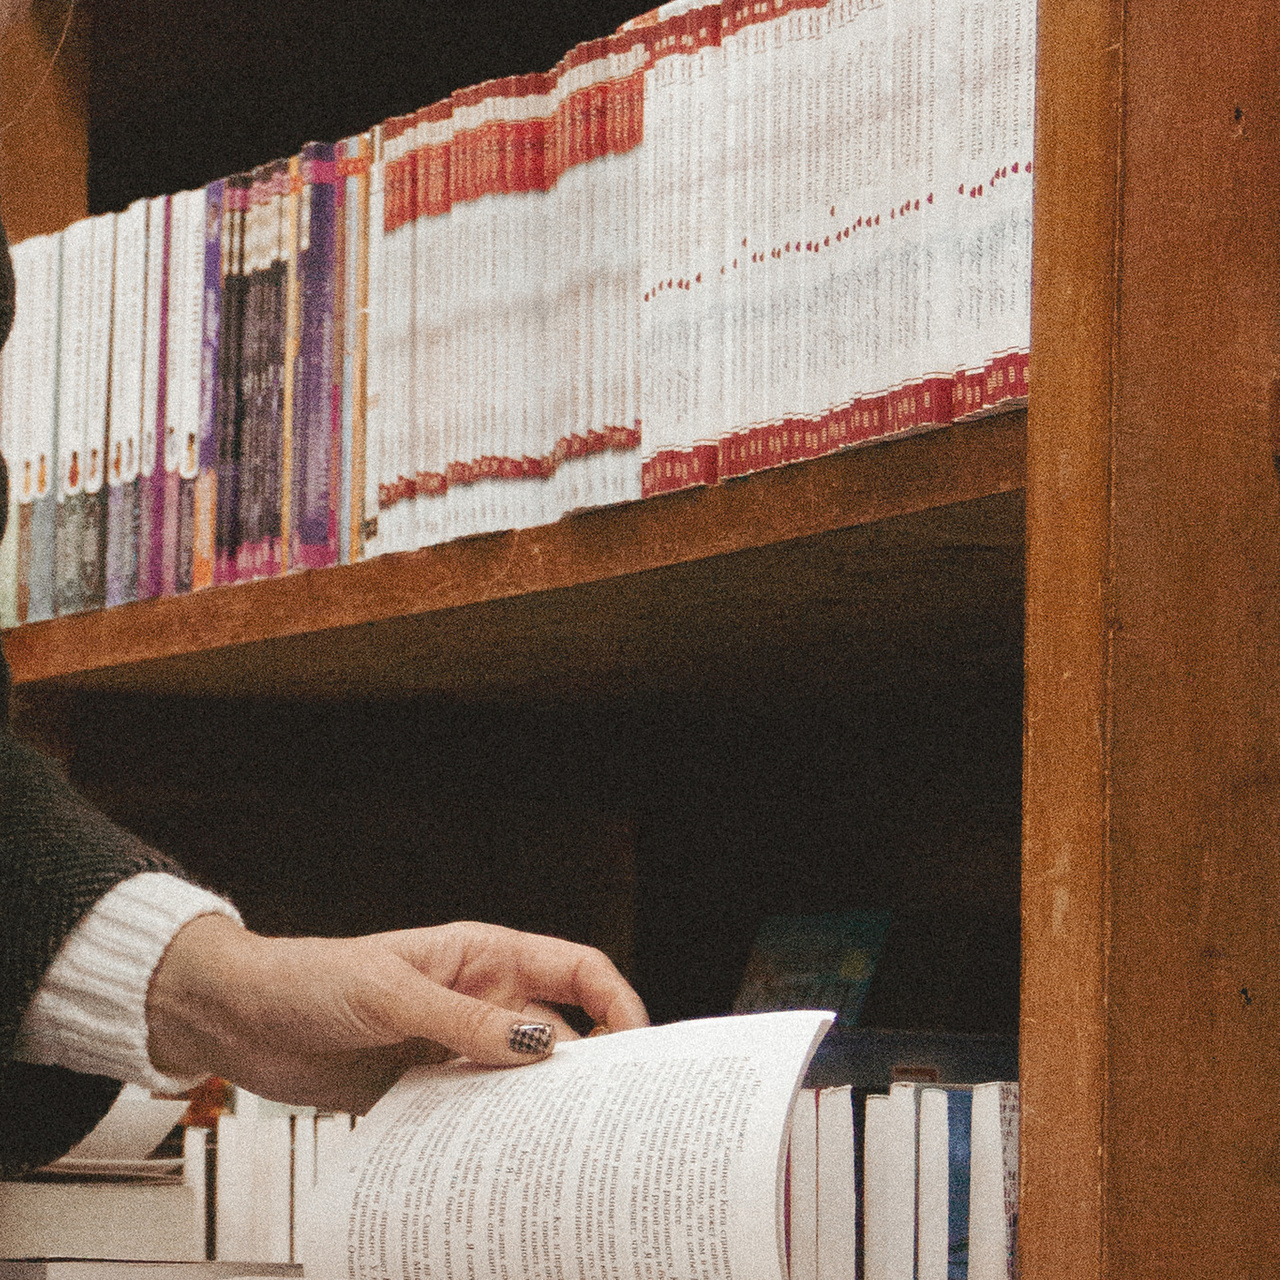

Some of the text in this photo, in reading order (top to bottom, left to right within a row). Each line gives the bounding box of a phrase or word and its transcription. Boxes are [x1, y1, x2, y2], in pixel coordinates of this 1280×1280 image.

[614, 1110, 634, 1162] полностью
[640, 1130, 649, 1147] что
[648, 1127, 660, 1152] меня
[472, 1155, 484, 1184] собой
[525, 1158, 536, 1180] дать
[636, 1150, 644, 1163] он
[654, 1120, 672, 1191] придерживает
[665, 1155, 677, 1185] дверь
[676, 1147, 689, 1191] рабочем
[691, 1150, 698, 1164] он
[720, 1147, 732, 1194] кабинете
[450, 1175, 459, 1190] так
[575, 1145, 591, 1213] происходило
[588, 1158, 599, 1188] когда
[598, 1163, 609, 1208] возраста
[633, 1167, 641, 1180] не
[642, 1154, 654, 1202] взглядом
[696, 1167, 707, 1207] потому,
[404, 1192, 412, 1209] для
[458, 1188, 466, 1198] за
[487, 1178, 500, 1218] сделать
[498, 1178, 511, 1228] чувствую
[522, 1182, 531, 1202] мне
[531, 1164, 544, 1218] улыбается
[609, 1166, 620, 1230] распахивает
[686, 1168, 697, 1220] способен
[412, 1214, 419, 1227] на
[442, 1195, 456, 1235] быстро
[456, 1202, 464, 1223] ним
[465, 1188, 476, 1240] поделать.
[629, 1185, 640, 1235] замечает,
[652, 1194, 661, 1226] рукой
[675, 1196, 683, 1225] месте
[708, 1204, 717, 1237] может
[720, 1200, 729, 1226] Кита
[380, 1211, 389, 1274] спрашивает
[520, 1206, 532, 1274] возможность
[542, 1221, 550, 1263] говорит
[575, 1216, 583, 1254] ничего
[596, 1218, 604, 1262] деловом
[652, 1228, 662, 1259] дверь
[687, 1224, 693, 1237] на
[608, 1233, 616, 1264] дверь
[687, 1241, 697, 1274] самые
[710, 1242, 719, 1273] сейчас
[500, 1264, 509, 1280] его
